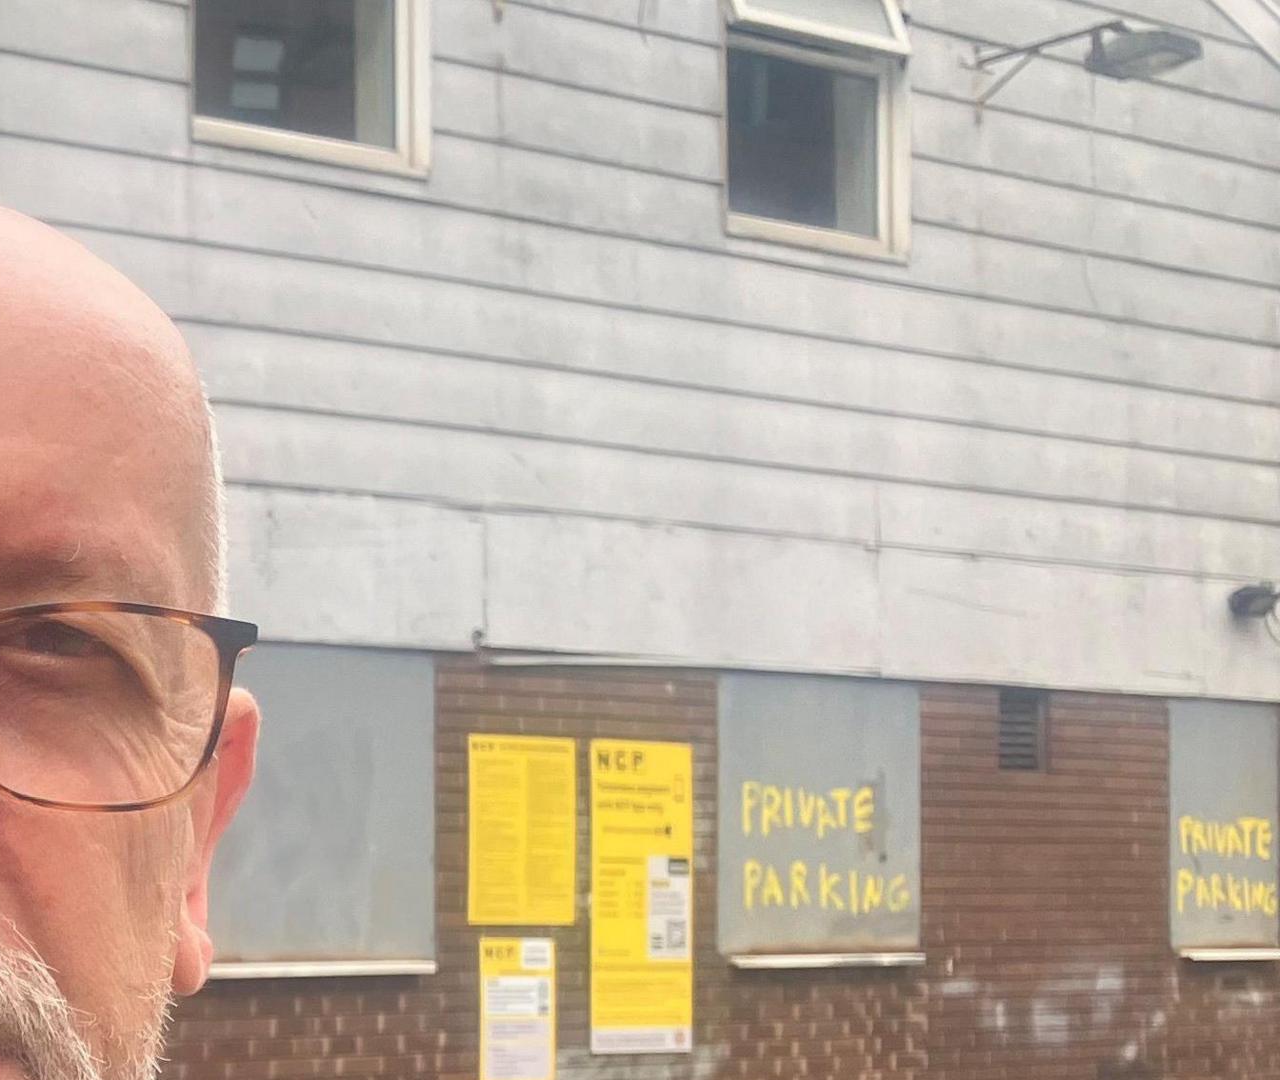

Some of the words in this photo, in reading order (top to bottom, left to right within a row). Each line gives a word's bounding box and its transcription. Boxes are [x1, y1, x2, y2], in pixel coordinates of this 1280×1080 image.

[598, 751, 644, 771] NCP
[743, 781, 874, 838] PRIVATE
[1180, 816, 1271, 859] PRIVATE
[744, 859, 912, 917] PARKING
[1177, 869, 1277, 916] PARKING
